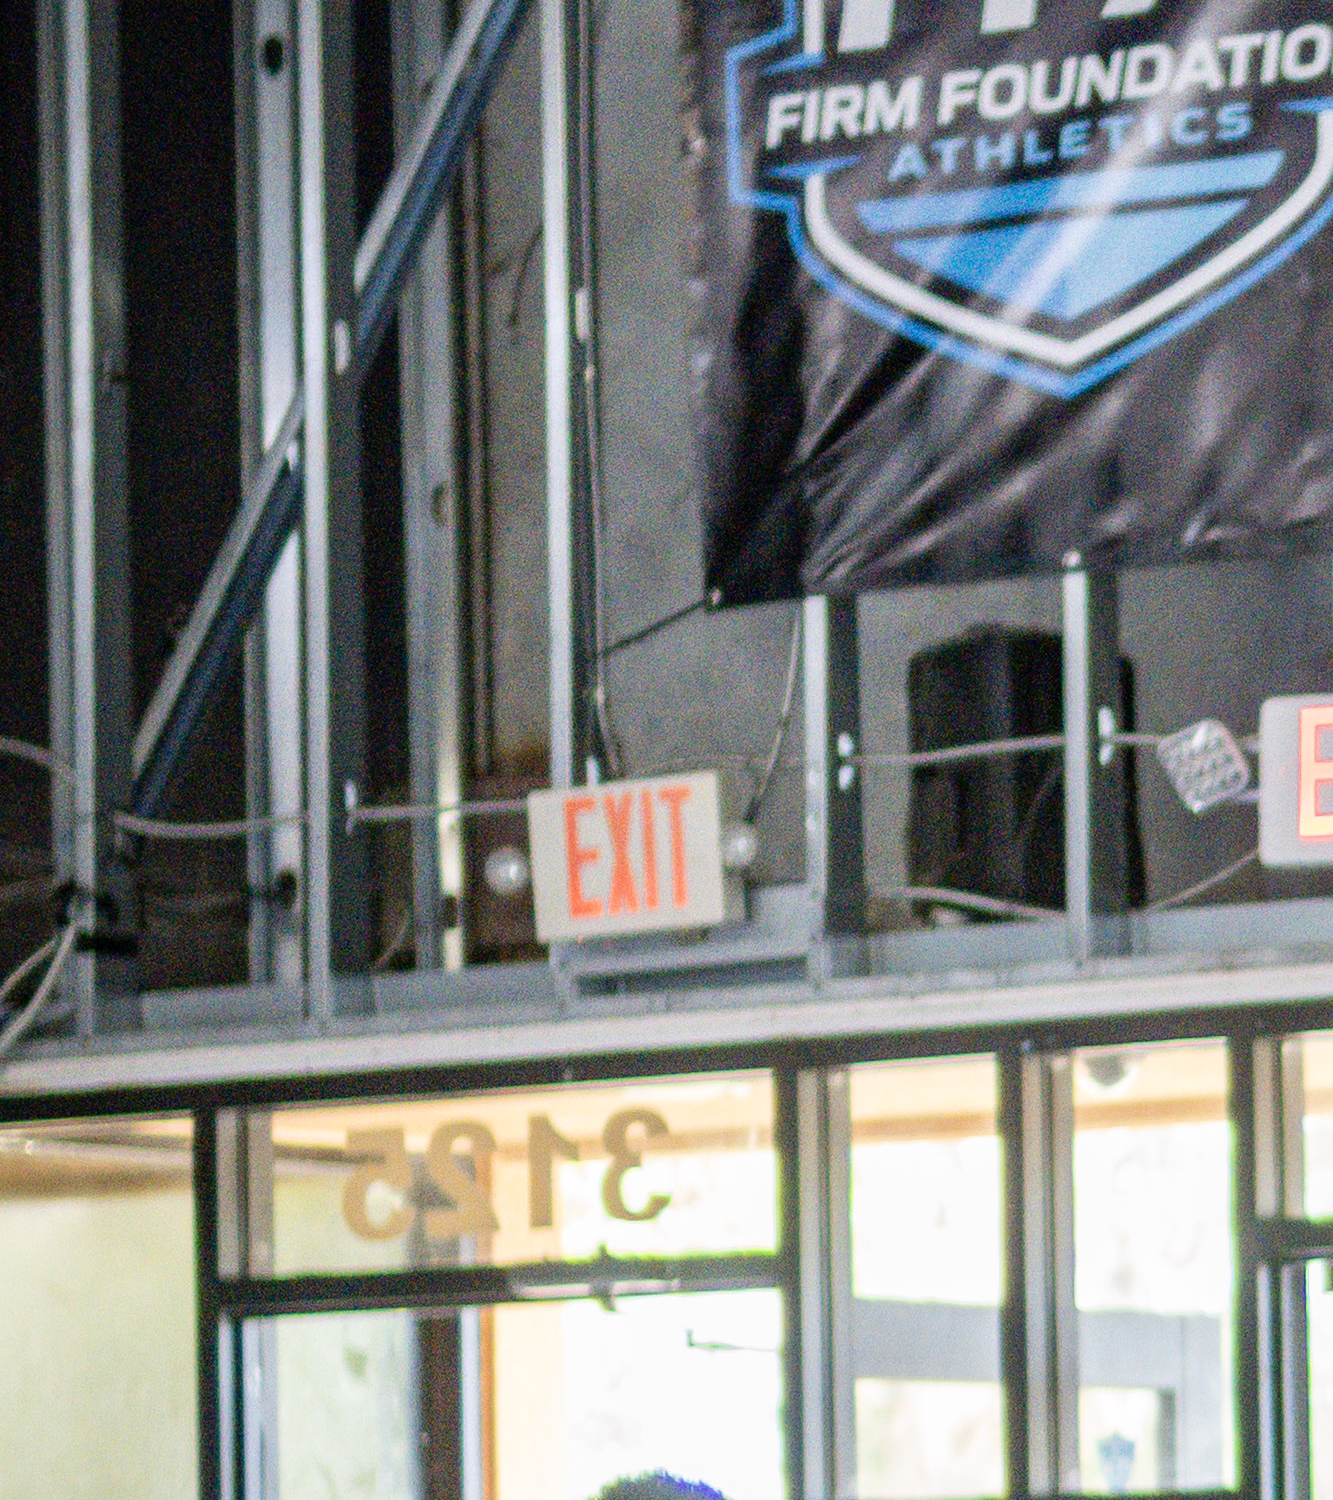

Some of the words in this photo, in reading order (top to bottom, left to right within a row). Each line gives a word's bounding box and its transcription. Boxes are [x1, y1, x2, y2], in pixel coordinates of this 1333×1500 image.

[765, 73, 921, 150] FIRM
[888, 102, 1253, 184] ATHLETICS
[563, 785, 694, 919] EXIT
